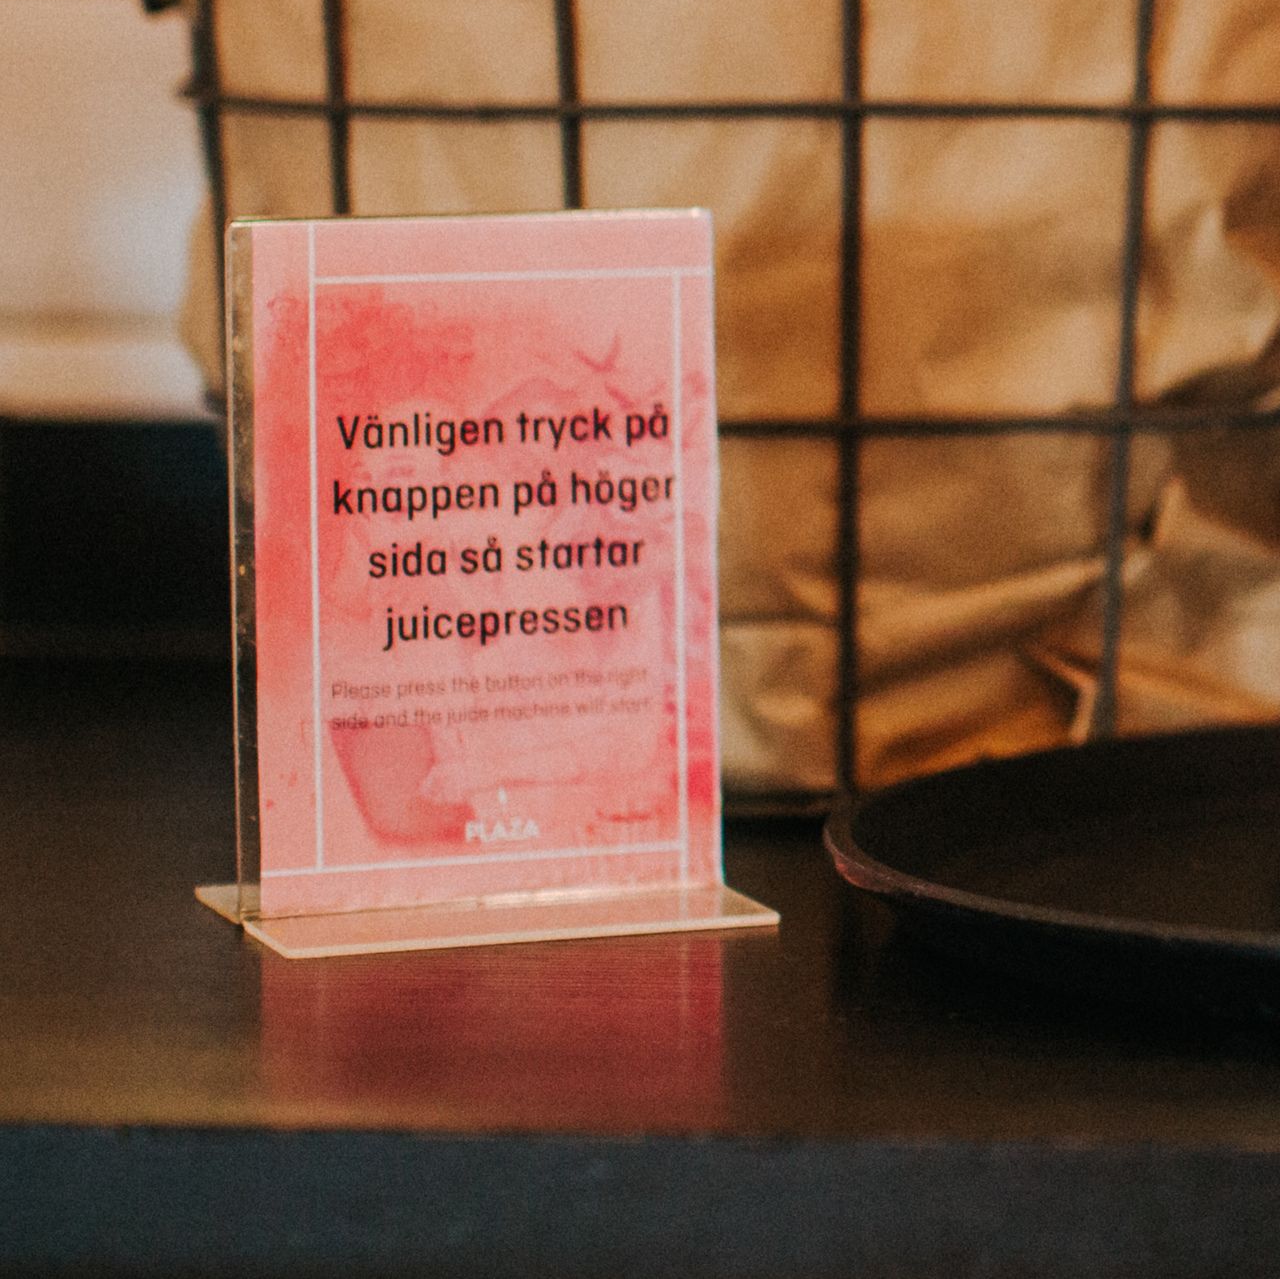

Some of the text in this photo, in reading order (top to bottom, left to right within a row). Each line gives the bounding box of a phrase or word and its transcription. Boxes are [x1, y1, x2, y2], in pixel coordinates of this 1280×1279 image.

[337, 403, 670, 456] Vänligen tryck på
[333, 470, 676, 521] knappen på höger
[368, 535, 645, 578] sida så startar
[383, 604, 628, 651] juicepressen
[331, 680, 391, 700] Please
[397, 681, 446, 701] press
[452, 676, 480, 694] the
[485, 674, 544, 693] button
[331, 713, 369, 730] side
[374, 709, 408, 729] and
[413, 707, 442, 725] the
